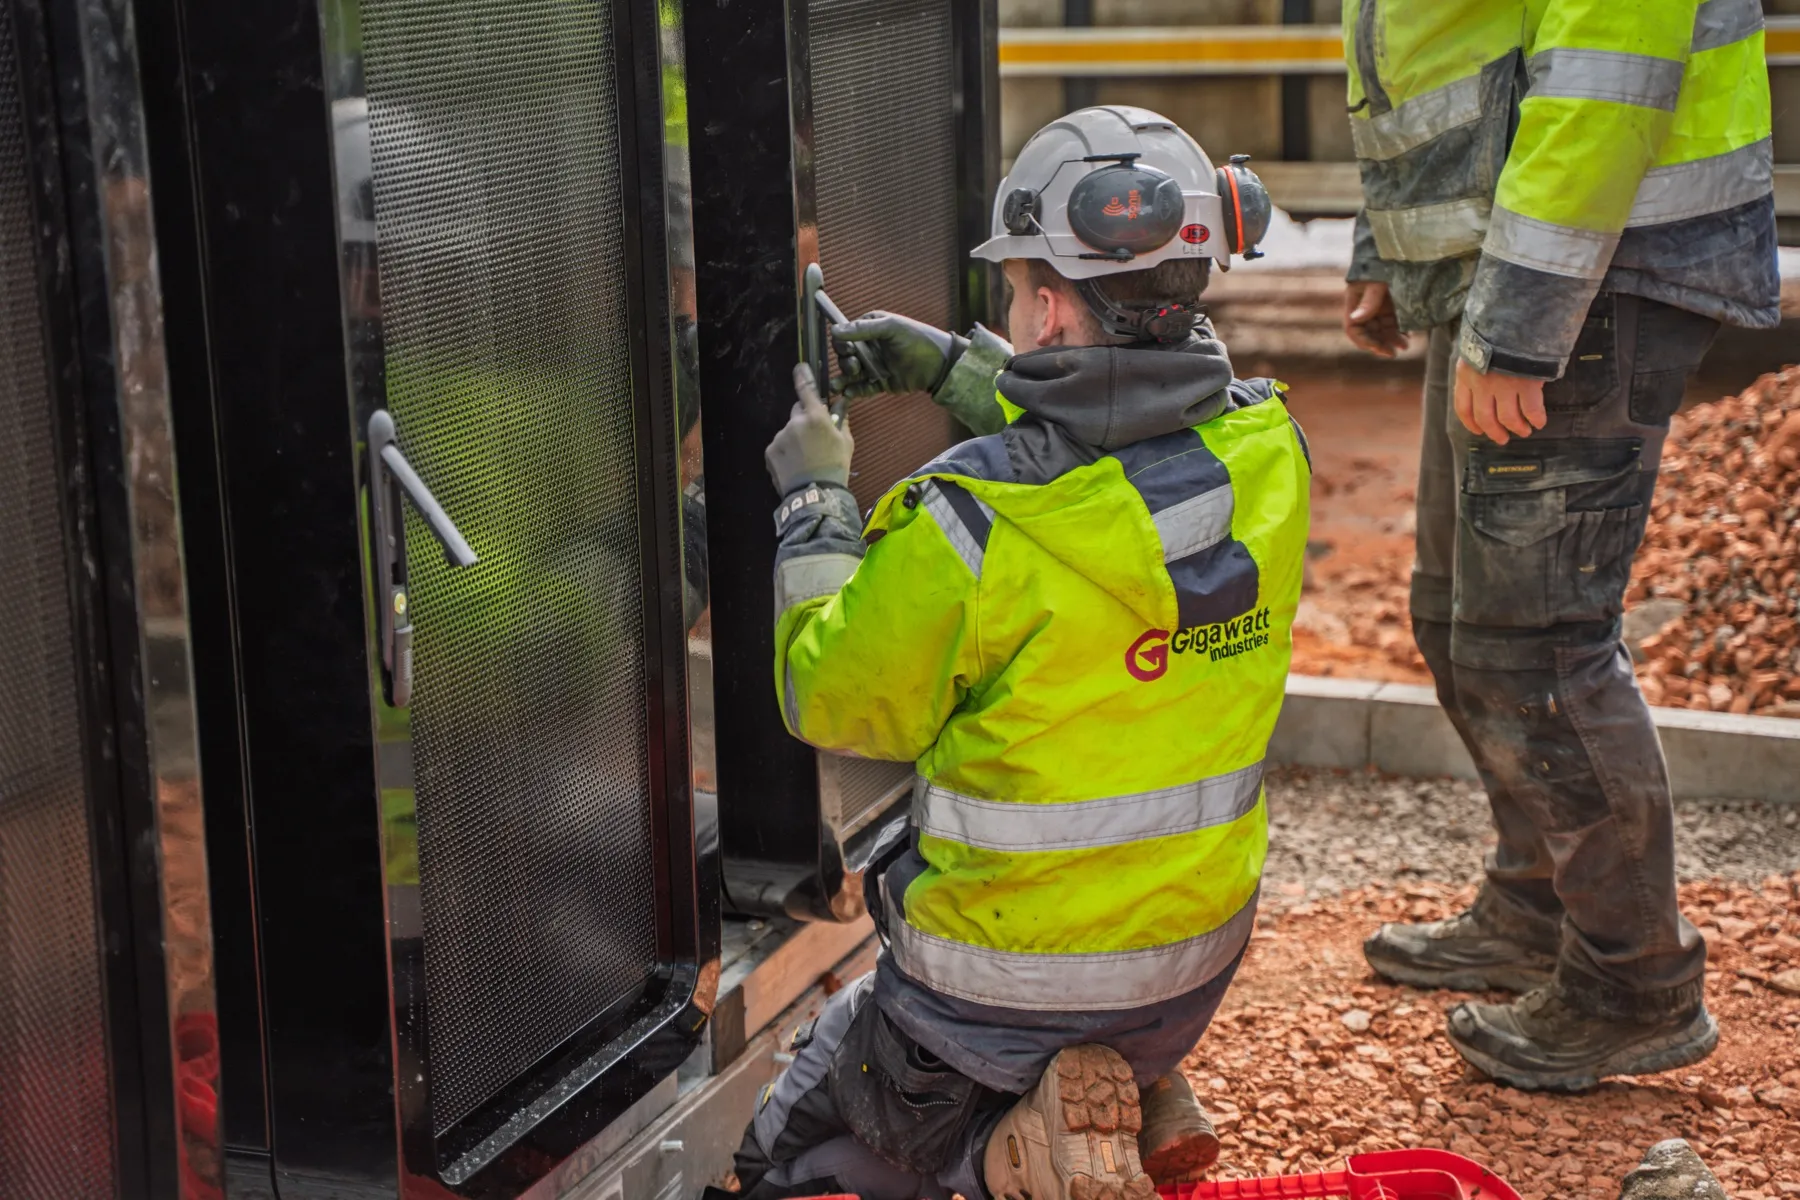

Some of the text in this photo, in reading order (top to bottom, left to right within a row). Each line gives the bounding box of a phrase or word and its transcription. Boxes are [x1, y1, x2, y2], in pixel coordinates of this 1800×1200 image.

[1184, 227, 1206, 240] JSP
[1182, 244, 1204, 255] LEE
[1171, 606, 1270, 654] Gigawatt
[1209, 632, 1269, 662] industries
